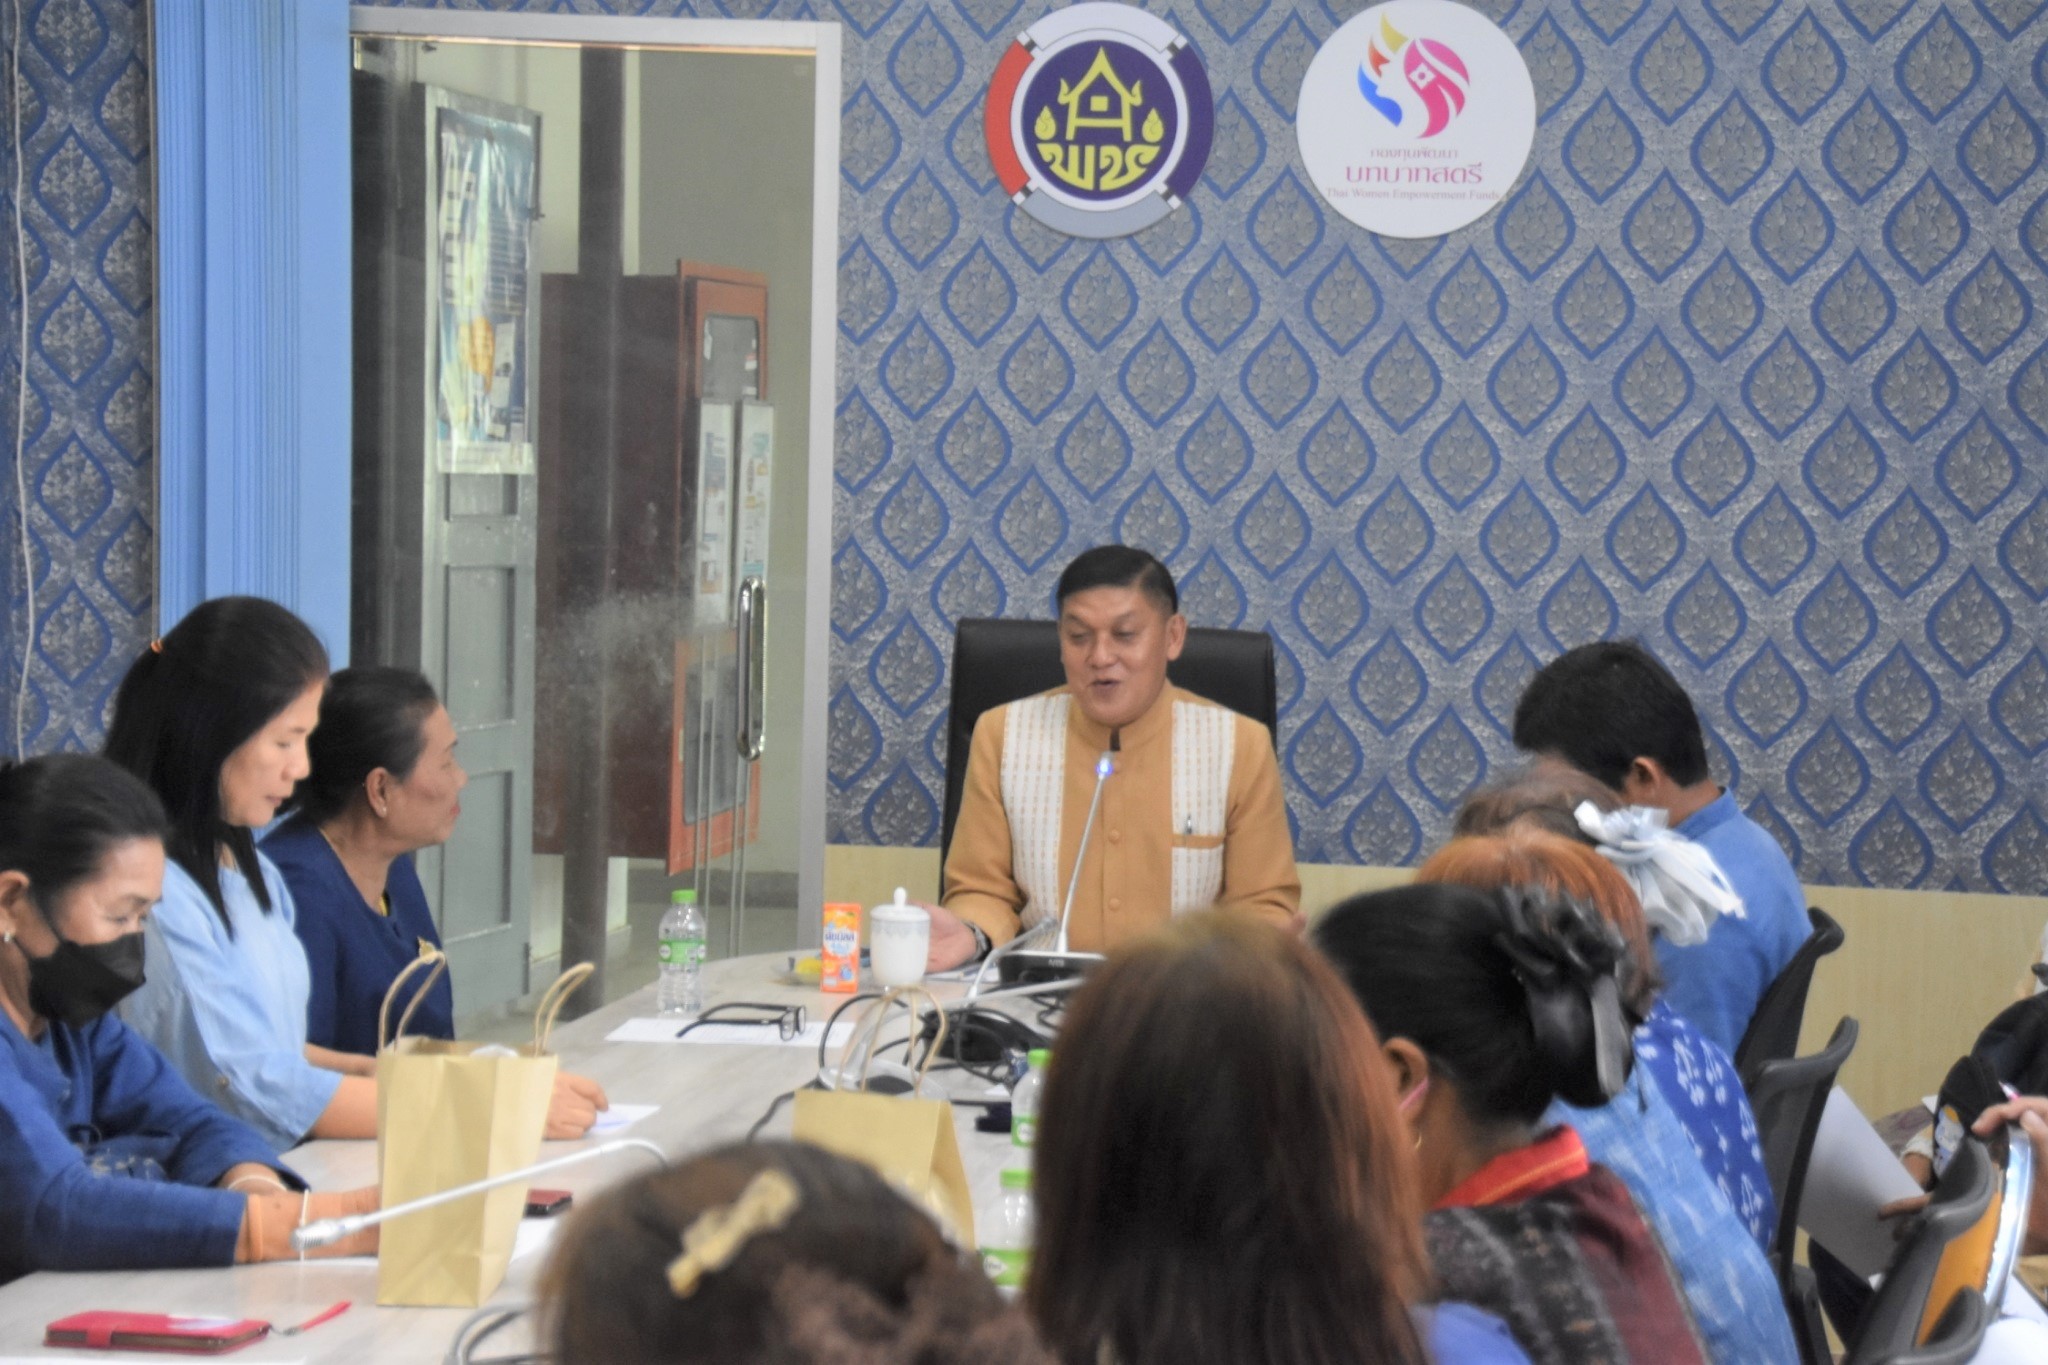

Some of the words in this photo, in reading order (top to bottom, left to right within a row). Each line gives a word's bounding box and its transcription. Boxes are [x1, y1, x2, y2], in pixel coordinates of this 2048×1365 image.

[1346, 162, 1482, 184] บทบาทสตรี
[1326, 187, 1348, 198] Thai
[1351, 189, 1388, 199] Women
[1392, 189, 1465, 201] Empowerment
[1469, 190, 1500, 200] Funds
